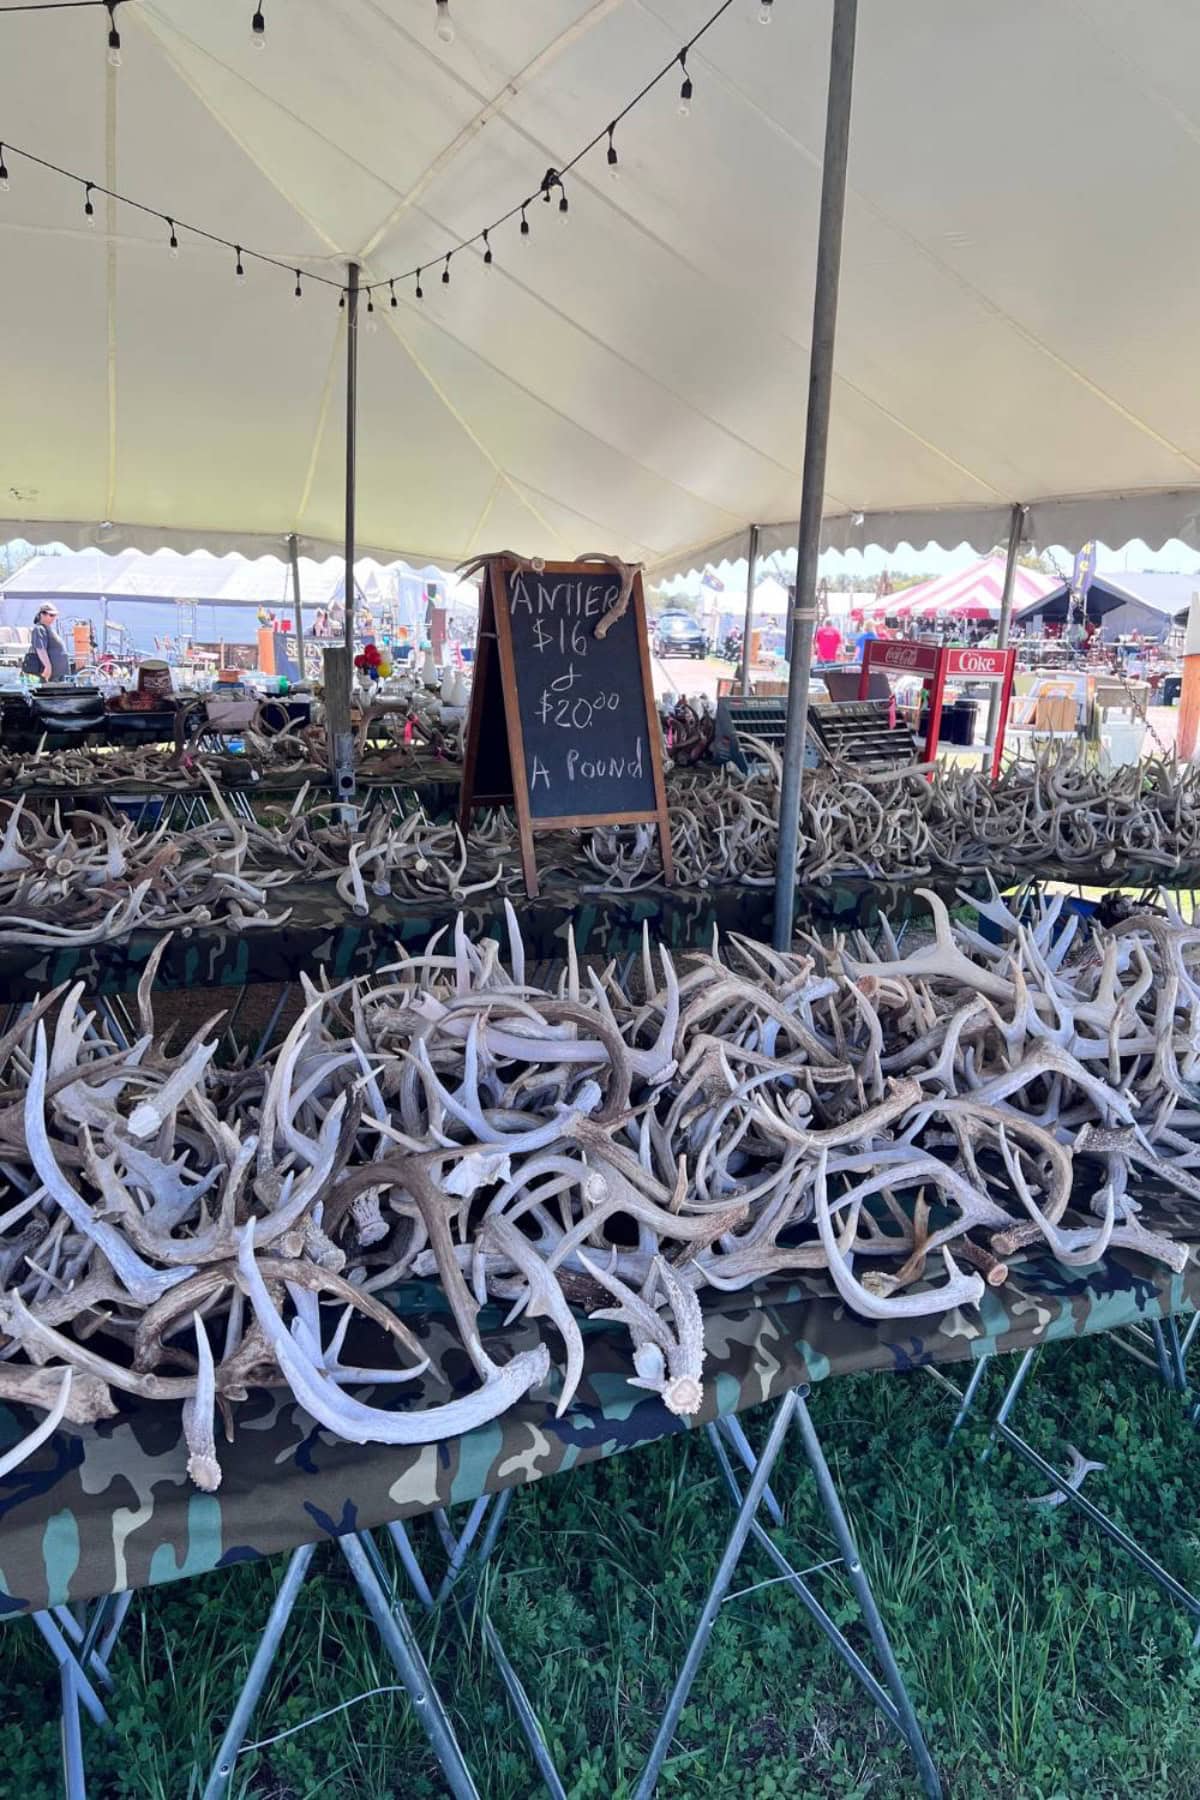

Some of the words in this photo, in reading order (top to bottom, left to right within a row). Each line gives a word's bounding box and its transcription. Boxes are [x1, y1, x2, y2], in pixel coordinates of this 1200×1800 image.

[531, 618, 588, 656] $16
[959, 652, 996, 671] Coke
[531, 755, 550, 790] A
